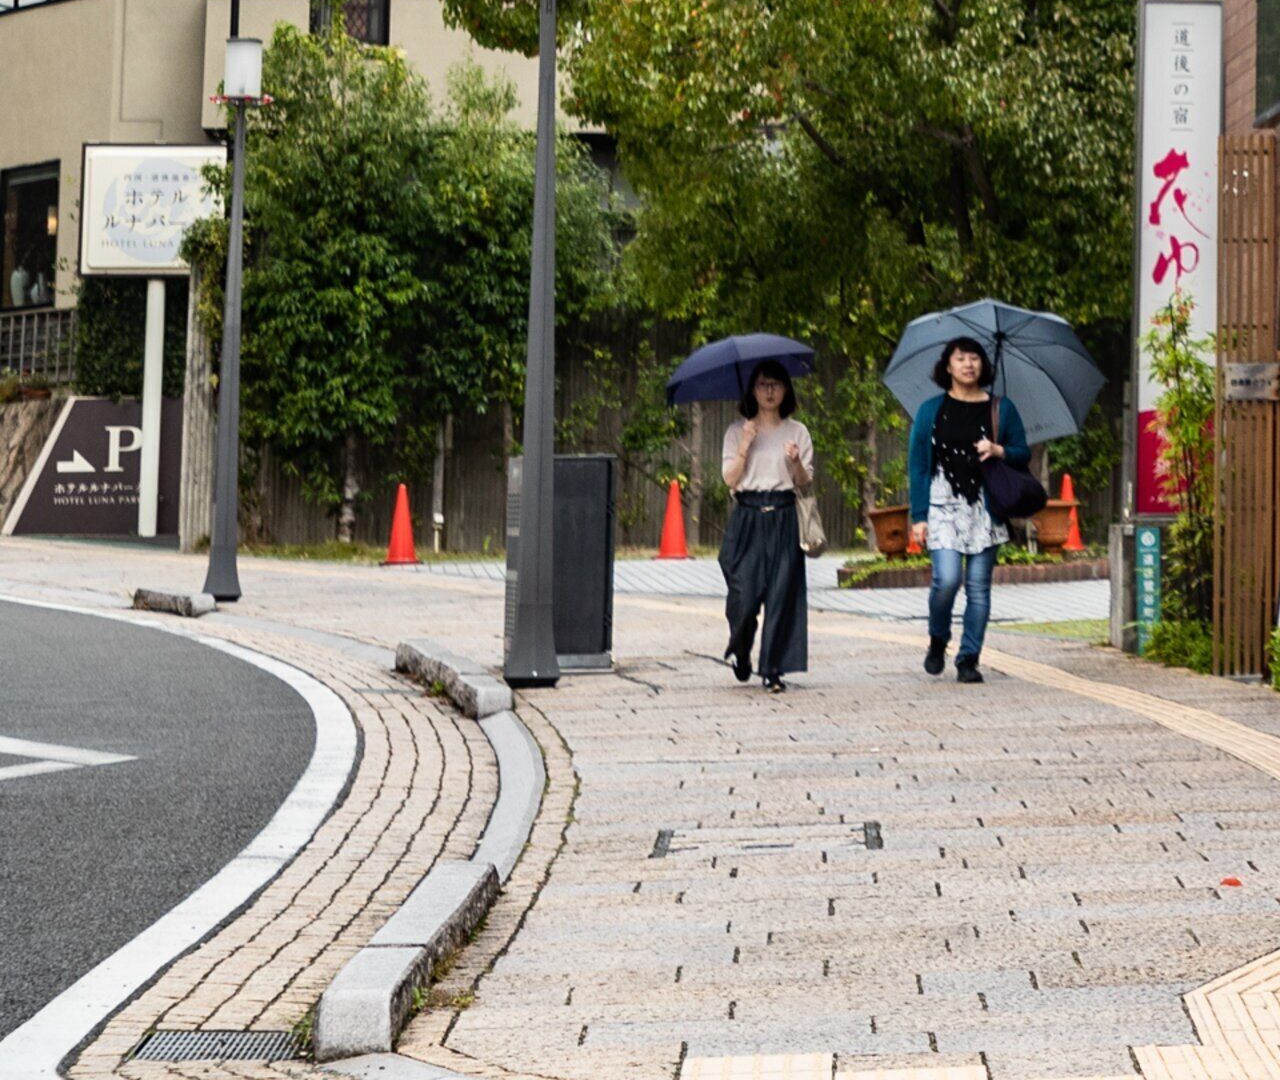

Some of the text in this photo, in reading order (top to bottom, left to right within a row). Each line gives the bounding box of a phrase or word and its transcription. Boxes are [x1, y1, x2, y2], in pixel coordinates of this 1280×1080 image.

[1174, 28, 1191, 125] 道後の宿
[125, 189, 188, 206] ホテル
[103, 213, 188, 232] ルナパー
[103, 425, 143, 472] P
[54, 482, 141, 495] ホテルルナパー
[53, 496, 86, 506] HOTEL
[88, 496, 116, 506] LUNA
